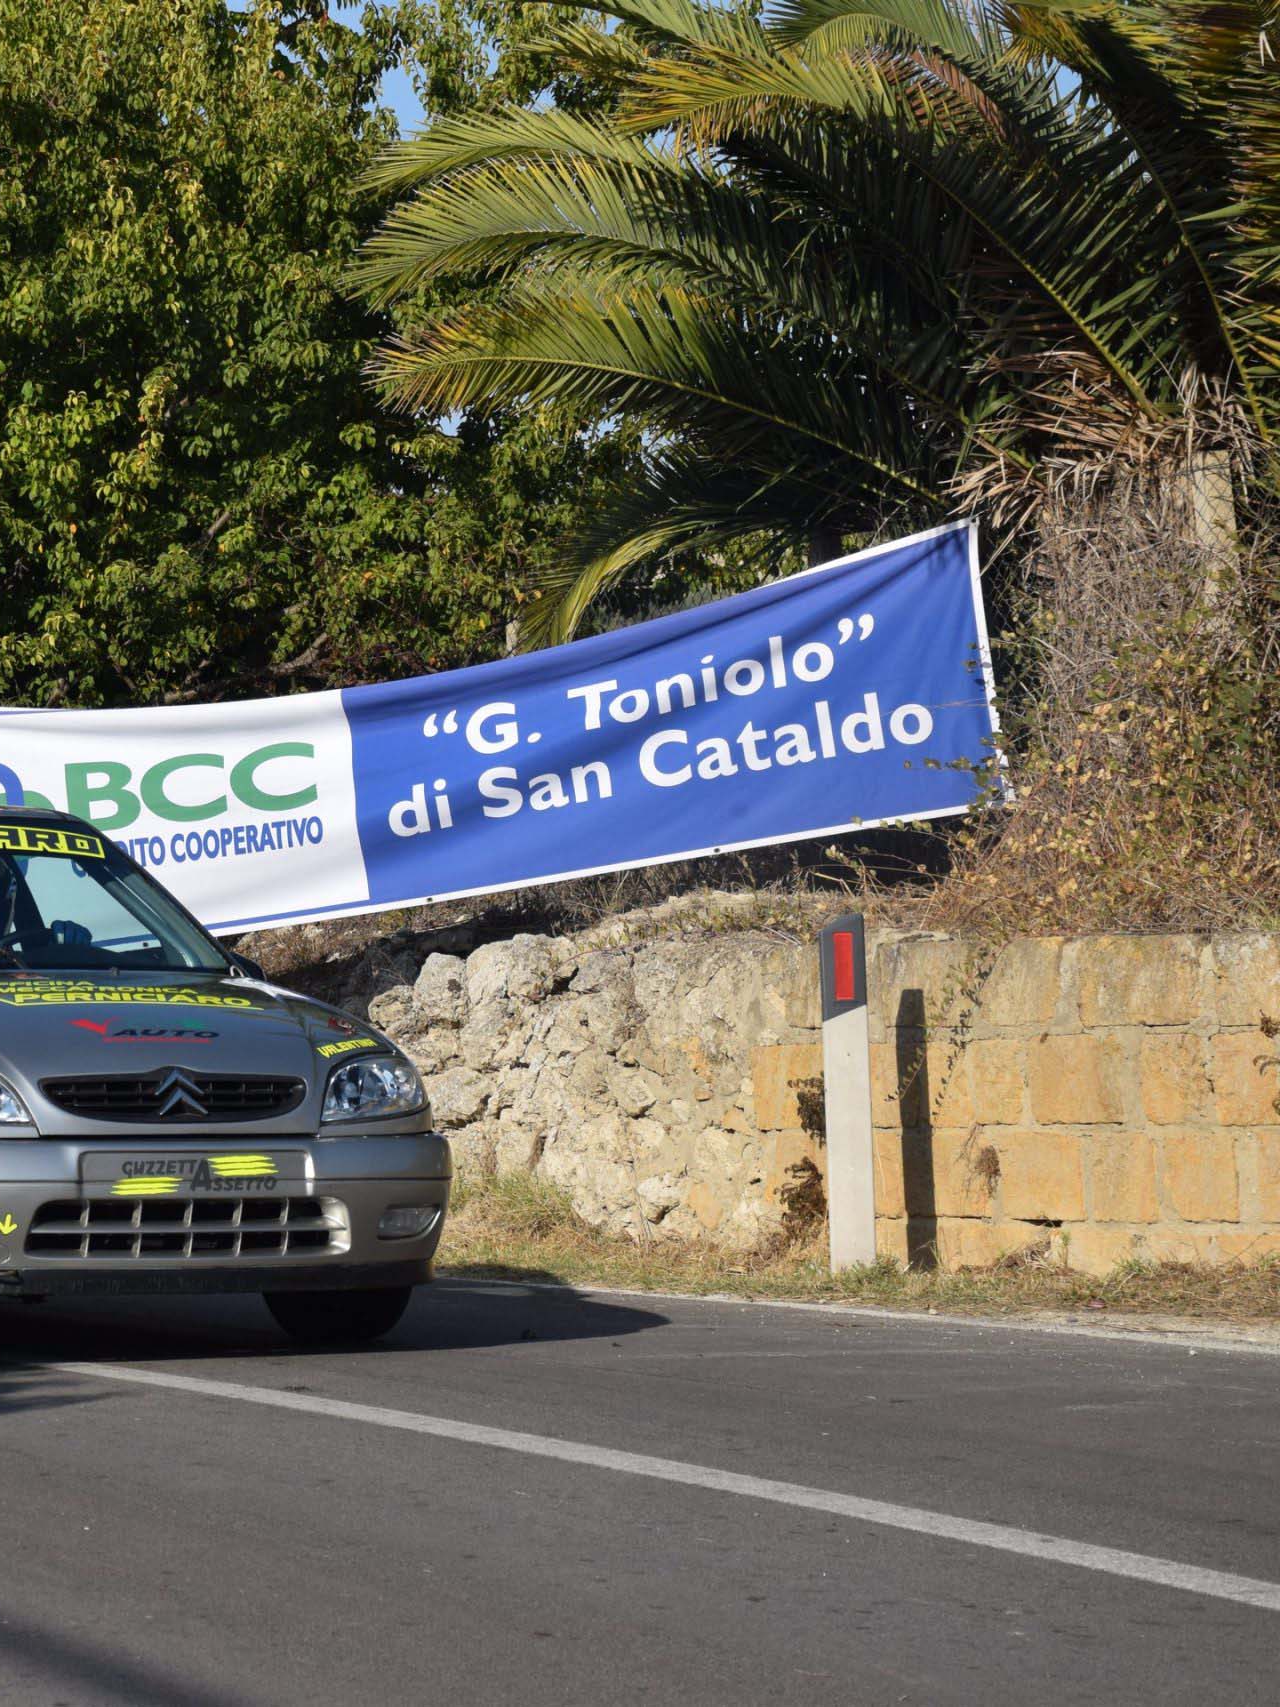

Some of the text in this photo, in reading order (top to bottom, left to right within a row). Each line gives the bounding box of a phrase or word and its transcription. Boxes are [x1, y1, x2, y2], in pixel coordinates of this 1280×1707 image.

[64, 742, 318, 831] BCC
[388, 692, 935, 838] di San Cataldo
[170, 816, 324, 863] COOPERATIVO
[14, 991, 252, 1008] PERNICIARO
[113, 1029, 220, 1039] AUTO
